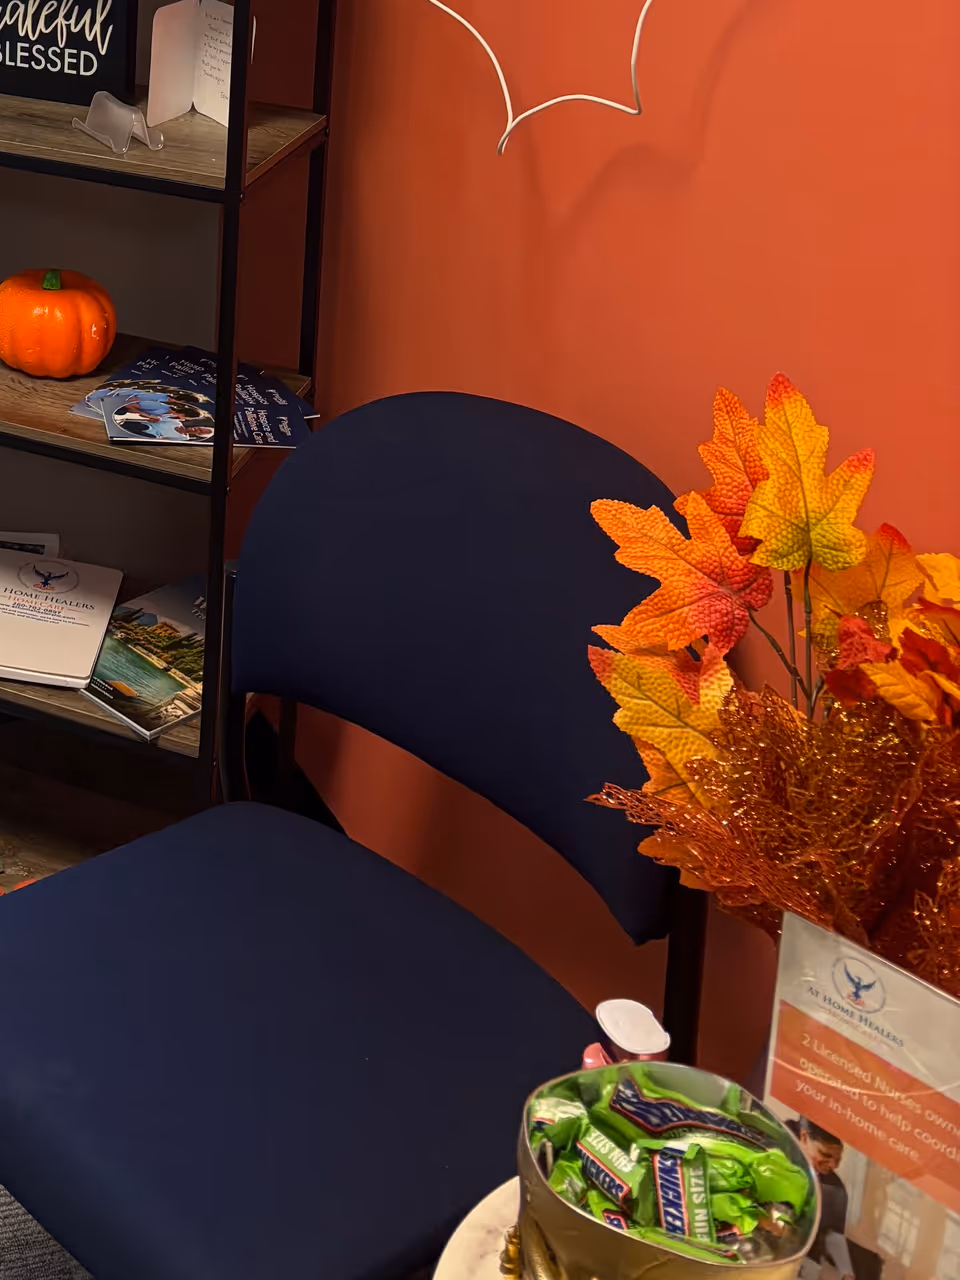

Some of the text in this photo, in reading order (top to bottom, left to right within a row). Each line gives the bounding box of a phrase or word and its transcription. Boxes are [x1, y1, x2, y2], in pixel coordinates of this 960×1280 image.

[3, 587, 41, 600] HOME
[44, 595, 96, 610] HEALERS
[7, 594, 66, 612] HOMECARE
[807, 986, 904, 1048] AT HOME HEALERS
[799, 1057, 861, 1100] operated
[862, 1095, 878, 1112] to
[879, 1104, 912, 1133] help
[802, 1033, 812, 1047] 2
[813, 1039, 872, 1084] Licensed
[874, 1075, 922, 1115] Nurses
[795, 1079, 920, 1162] your in-home care.
[689, 1166, 710, 1243] FUN SIZE
